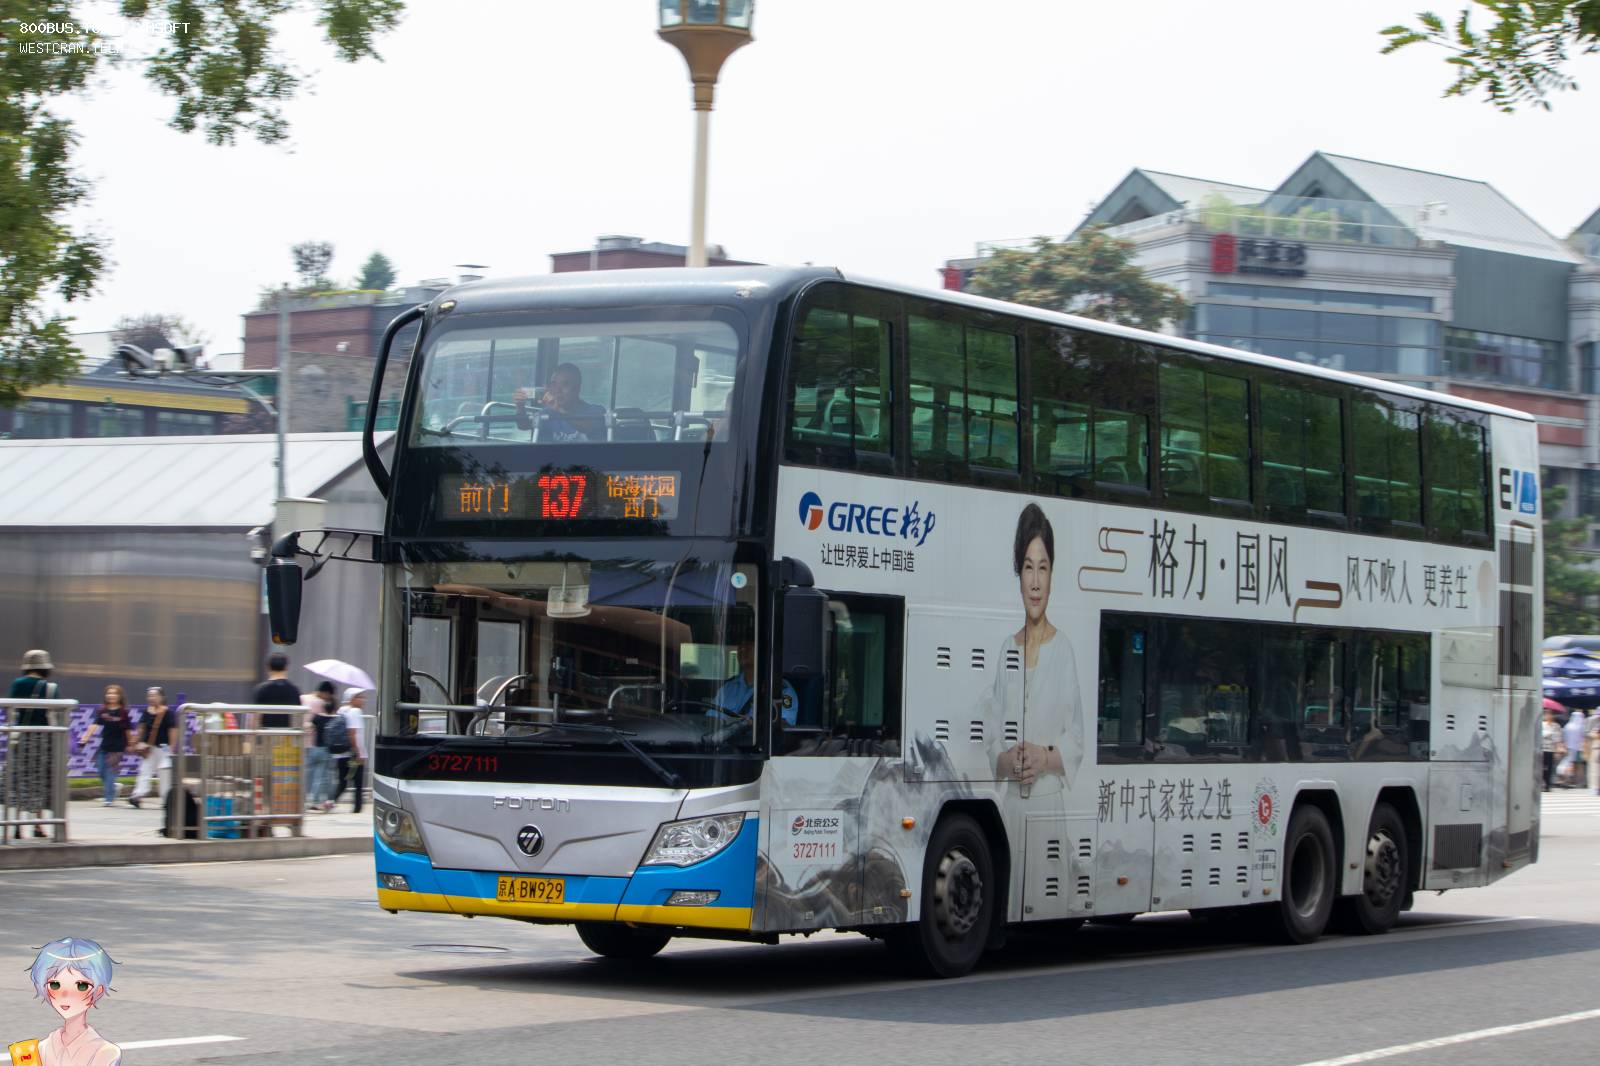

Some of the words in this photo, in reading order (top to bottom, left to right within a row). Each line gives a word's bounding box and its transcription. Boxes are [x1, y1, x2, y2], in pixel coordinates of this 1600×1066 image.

[460, 482, 509, 513] 前门
[538, 475, 586, 518] 137
[606, 475, 675, 498] 怡海花园
[623, 496, 658, 519] 西门
[828, 502, 898, 536] GREE
[821, 543, 915, 573] 让世界爱上中国造
[1346, 556, 1412, 605] 风不吹人
[1423, 564, 1468, 609] 更养生
[428, 755, 497, 772] 3727111
[1098, 778, 1232, 824] 新中式家装之选
[804, 818, 839, 827] 北京公交
[794, 843, 836, 858] 3727111
